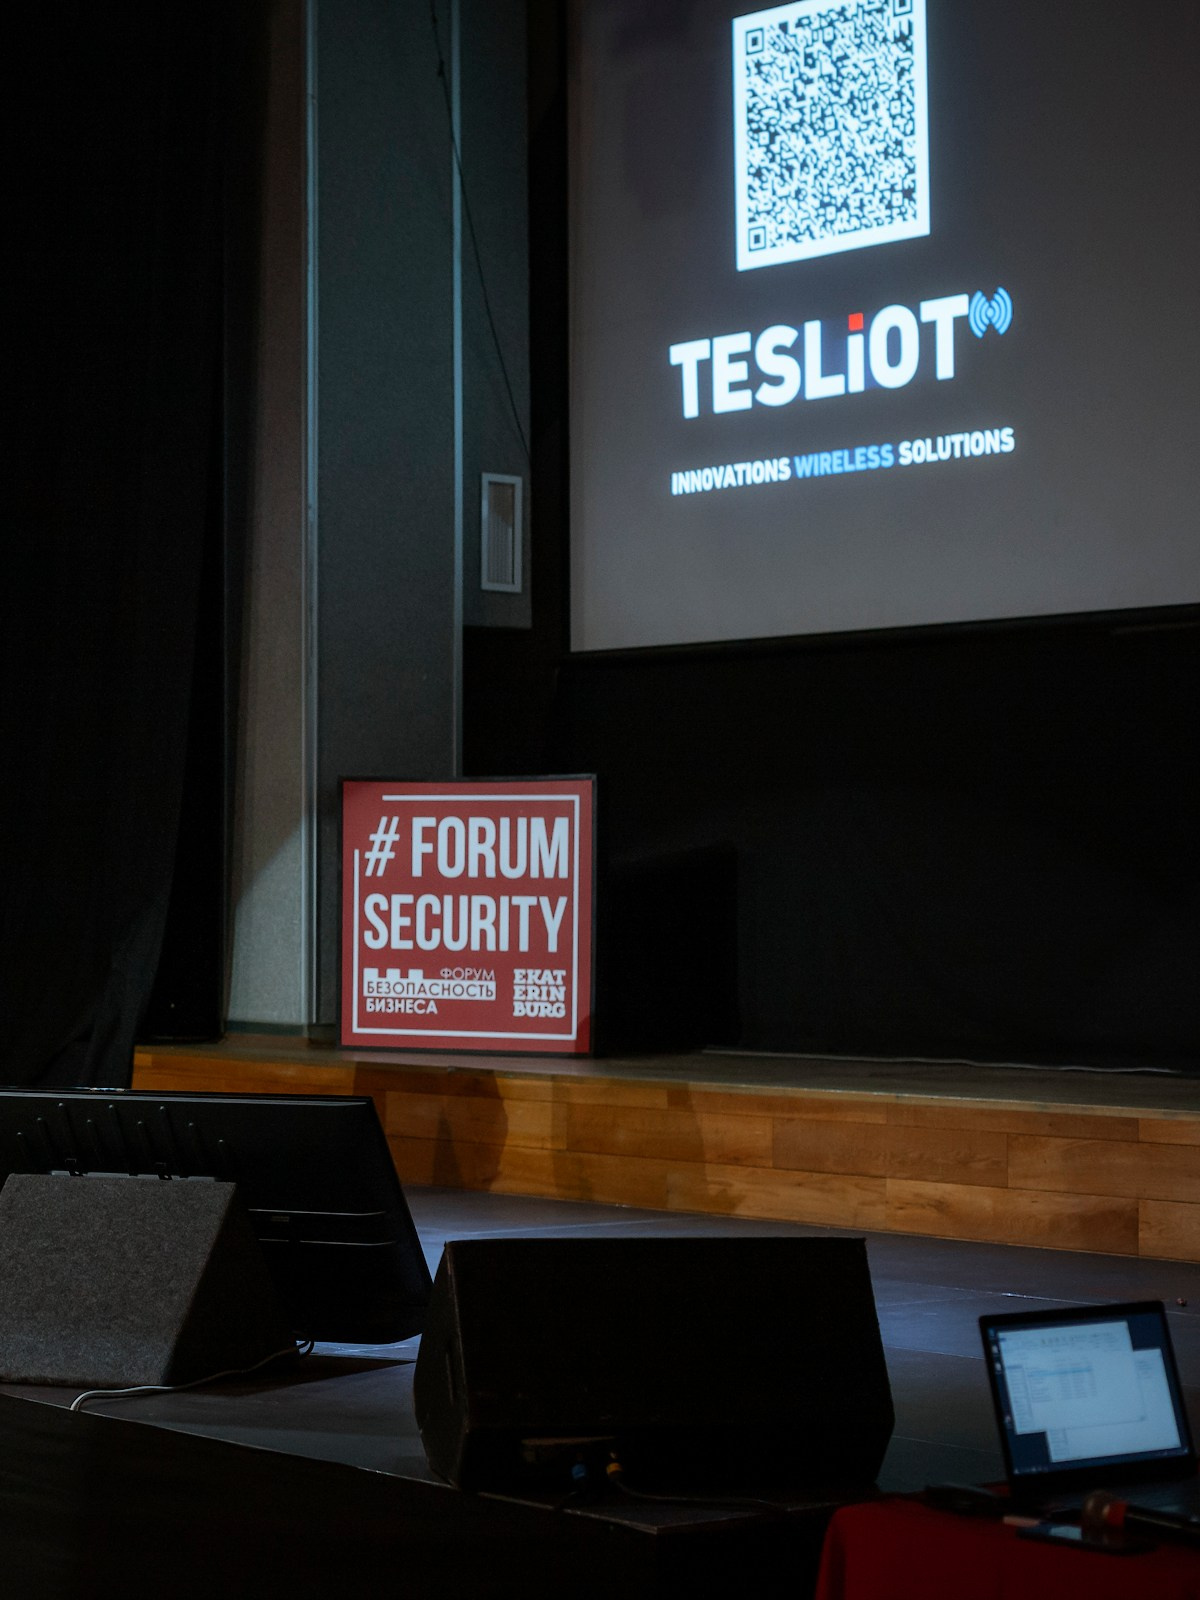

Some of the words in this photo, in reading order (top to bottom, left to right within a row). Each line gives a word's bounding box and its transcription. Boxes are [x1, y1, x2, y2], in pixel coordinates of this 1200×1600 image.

[669, 293, 969, 419] TESLiOT
[671, 457, 791, 496] INNOVATIONS
[794, 444, 894, 479] WIRELESS
[898, 427, 1015, 466] SOLUTIONS
[411, 816, 569, 879] FORUM
[363, 893, 568, 953] SECURITY
[439, 967, 496, 981] ФОРУМ
[513, 968, 567, 985] EKAT
[366, 980, 494, 998] БЕЗОПАСНОСТЬ
[513, 985, 566, 1002] ERIN
[365, 998, 438, 1015] БИЗНЕСА
[512, 1001, 567, 1018] BURG
